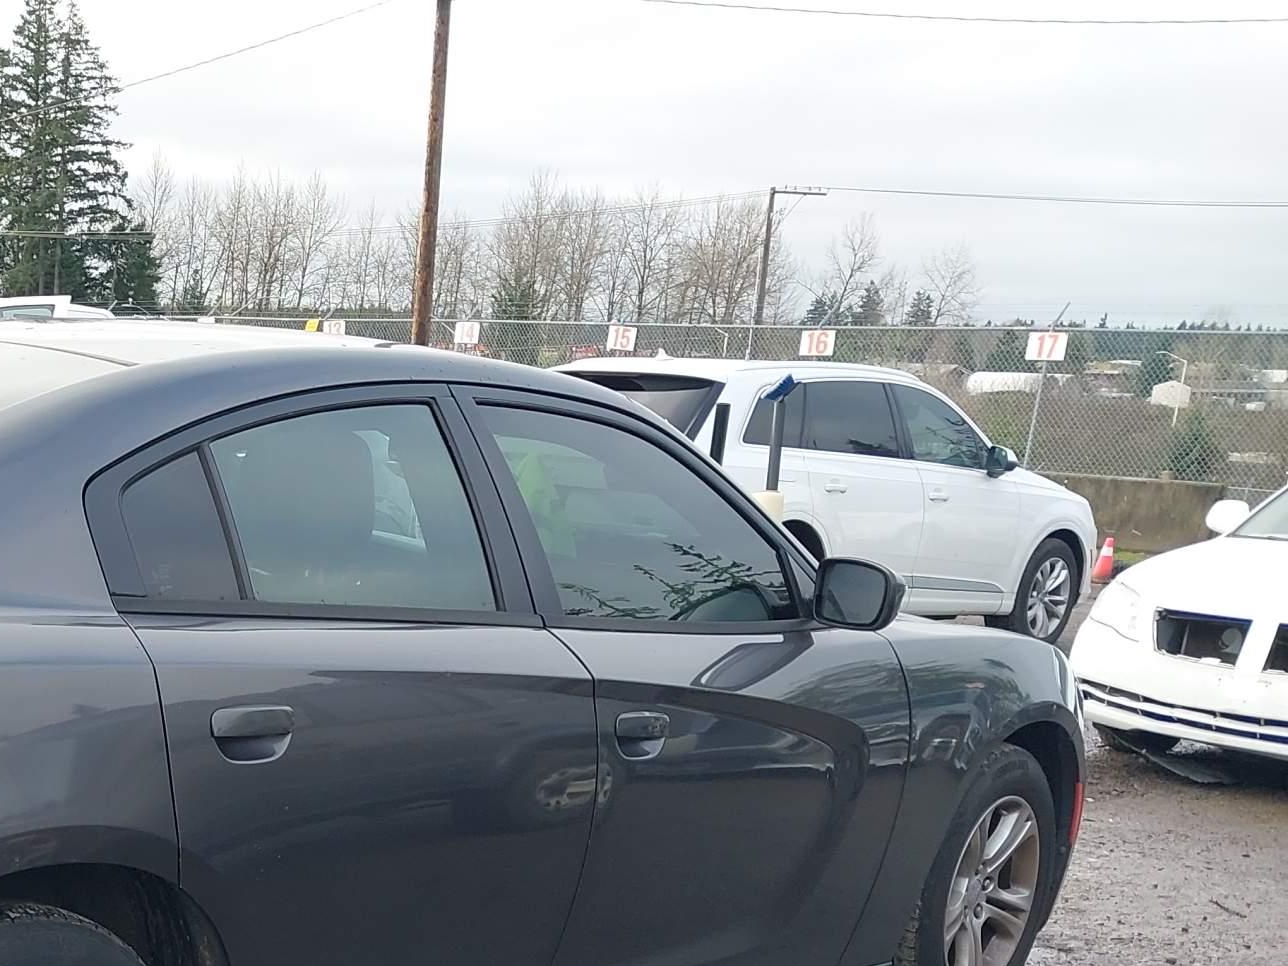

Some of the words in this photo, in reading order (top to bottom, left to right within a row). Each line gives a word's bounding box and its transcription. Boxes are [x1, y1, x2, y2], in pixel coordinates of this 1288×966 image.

[460, 323, 474, 341] 14
[614, 327, 631, 348] 15
[807, 331, 829, 354] 16
[1036, 334, 1060, 358] 17
